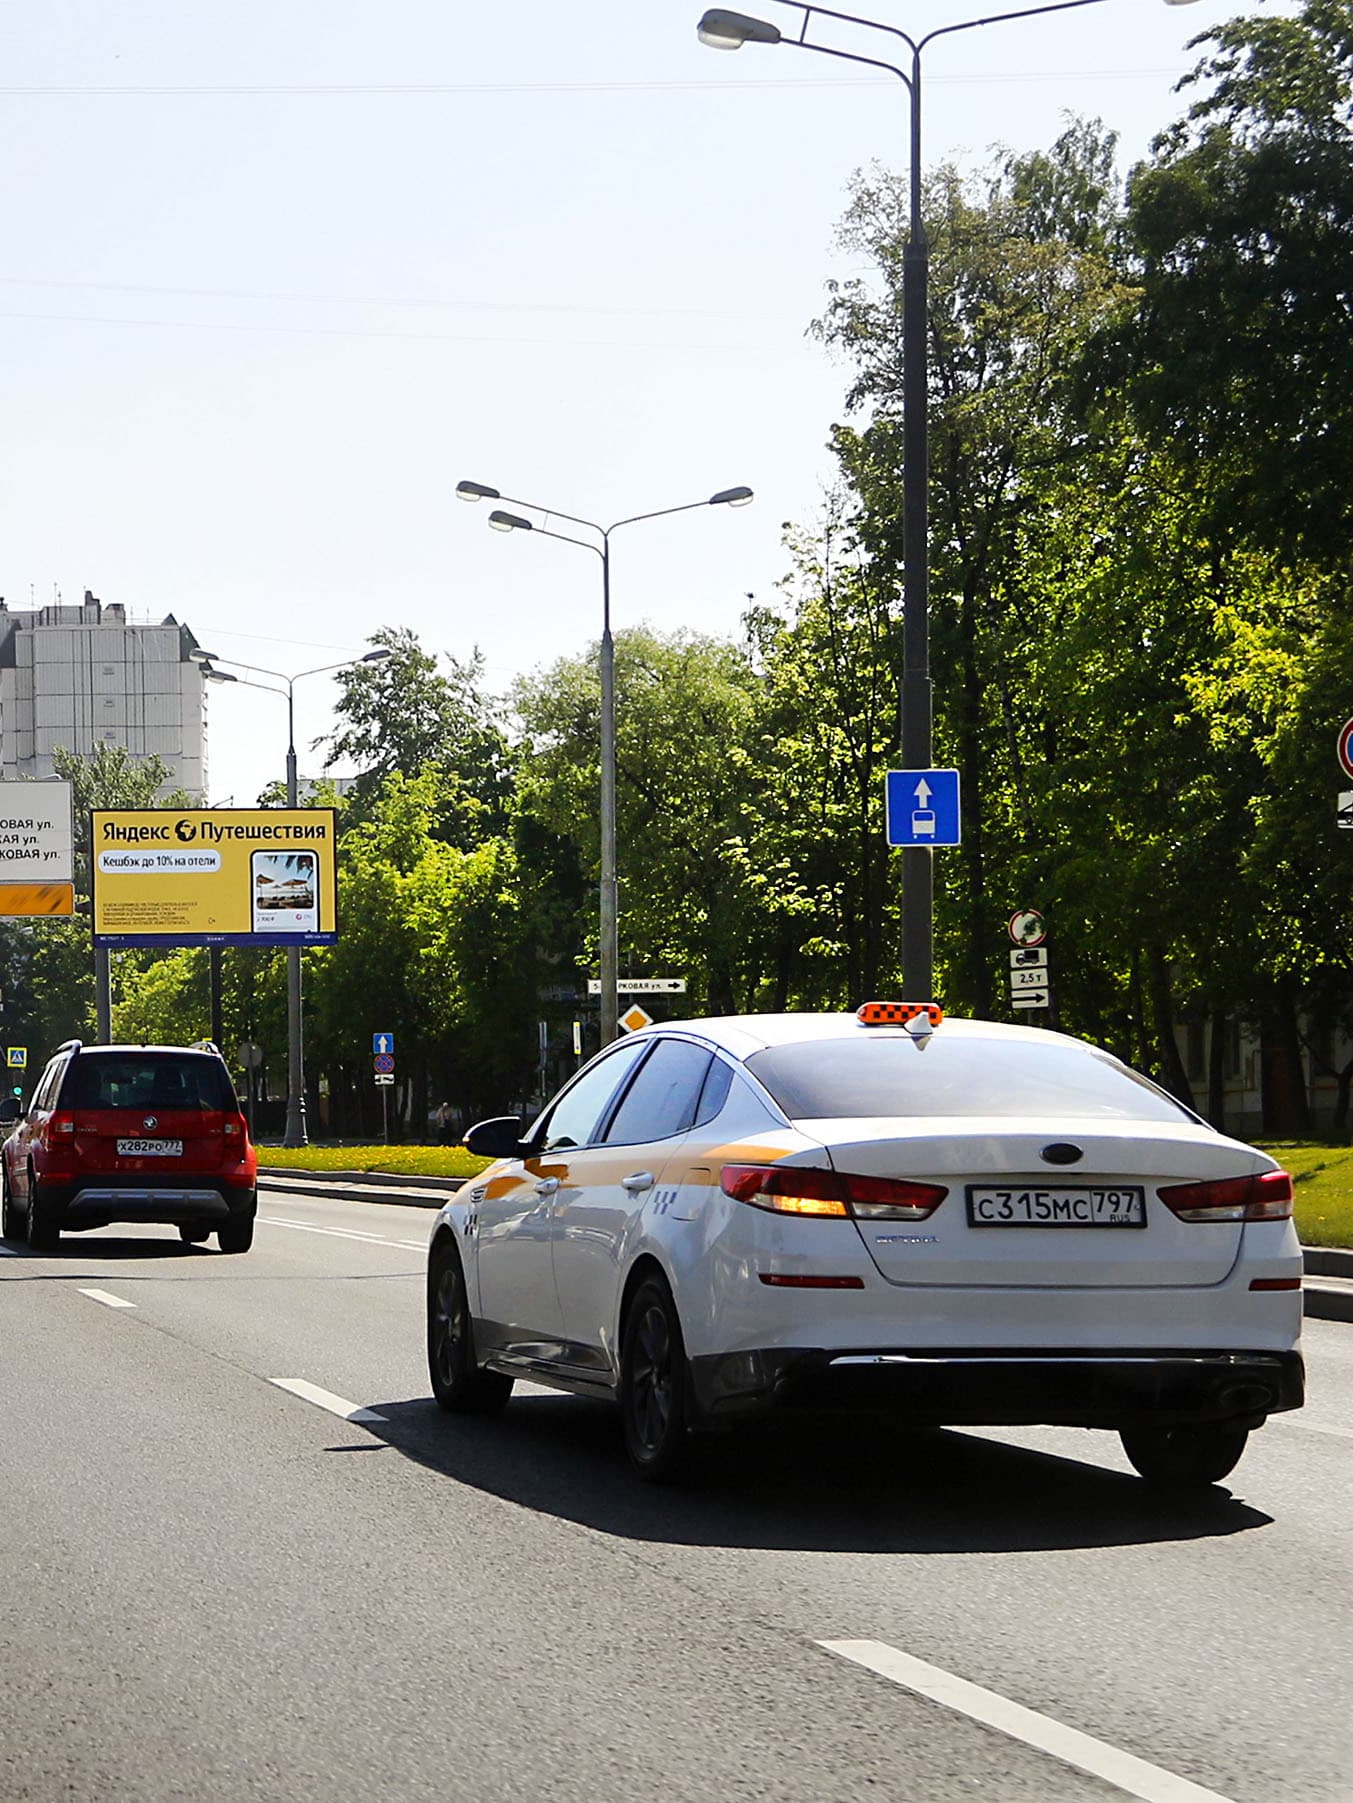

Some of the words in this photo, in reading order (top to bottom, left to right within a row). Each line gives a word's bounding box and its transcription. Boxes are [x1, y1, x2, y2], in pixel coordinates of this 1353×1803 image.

[37, 821, 55, 831] ул.
[103, 823, 170, 842] Яндекс
[201, 822, 326, 842] Путешествия
[22, 836, 40, 846] ул.
[43, 850, 61, 861] ул.
[103, 856, 140, 867] Кешбэк
[142, 857, 154, 867] до
[157, 855, 173, 866] 10%
[175, 857, 186, 866] на
[188, 857, 216, 866] отели
[1020, 973, 1034, 983] 2,5
[120, 1141, 162, 1152] Х282РО
[978, 1192, 1089, 1221] С315МС
[1093, 1192, 1136, 1213] 797
[1109, 1214, 1131, 1223] RUS
